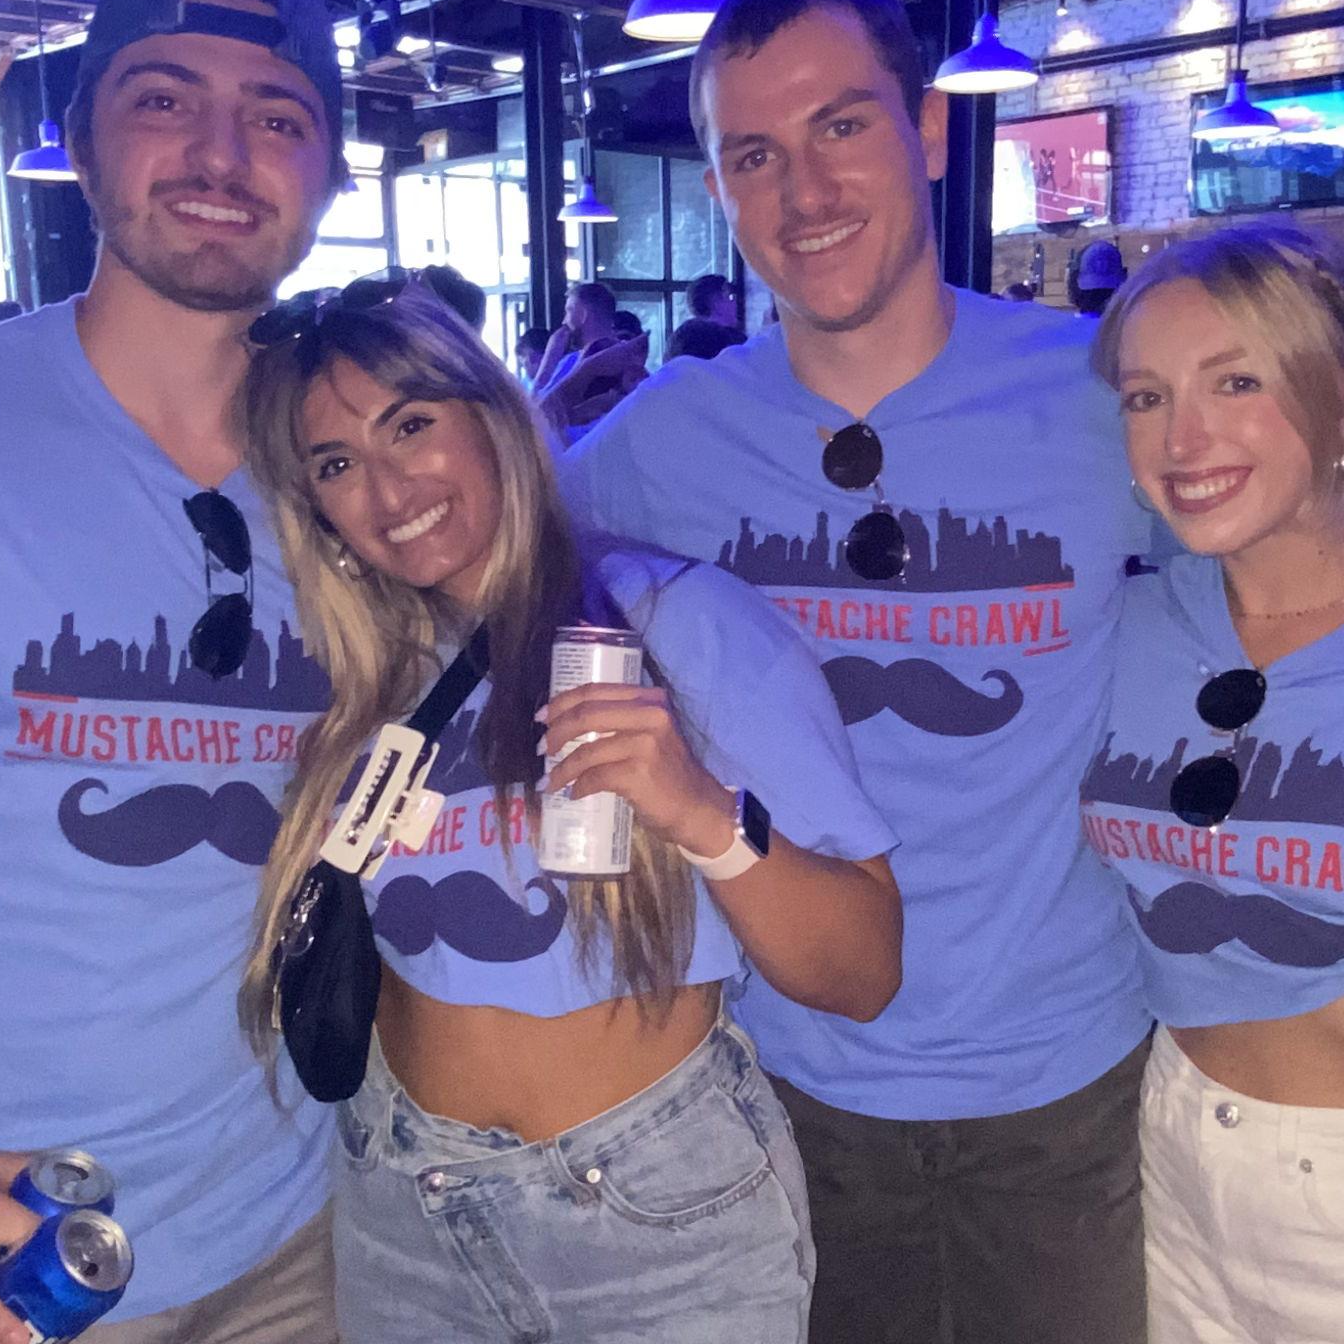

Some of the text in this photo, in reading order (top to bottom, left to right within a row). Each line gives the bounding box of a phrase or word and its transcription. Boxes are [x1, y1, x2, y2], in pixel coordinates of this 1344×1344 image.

[771, 596, 1070, 646] TACHE CRAWL
[16, 707, 242, 764] MUSTACHE
